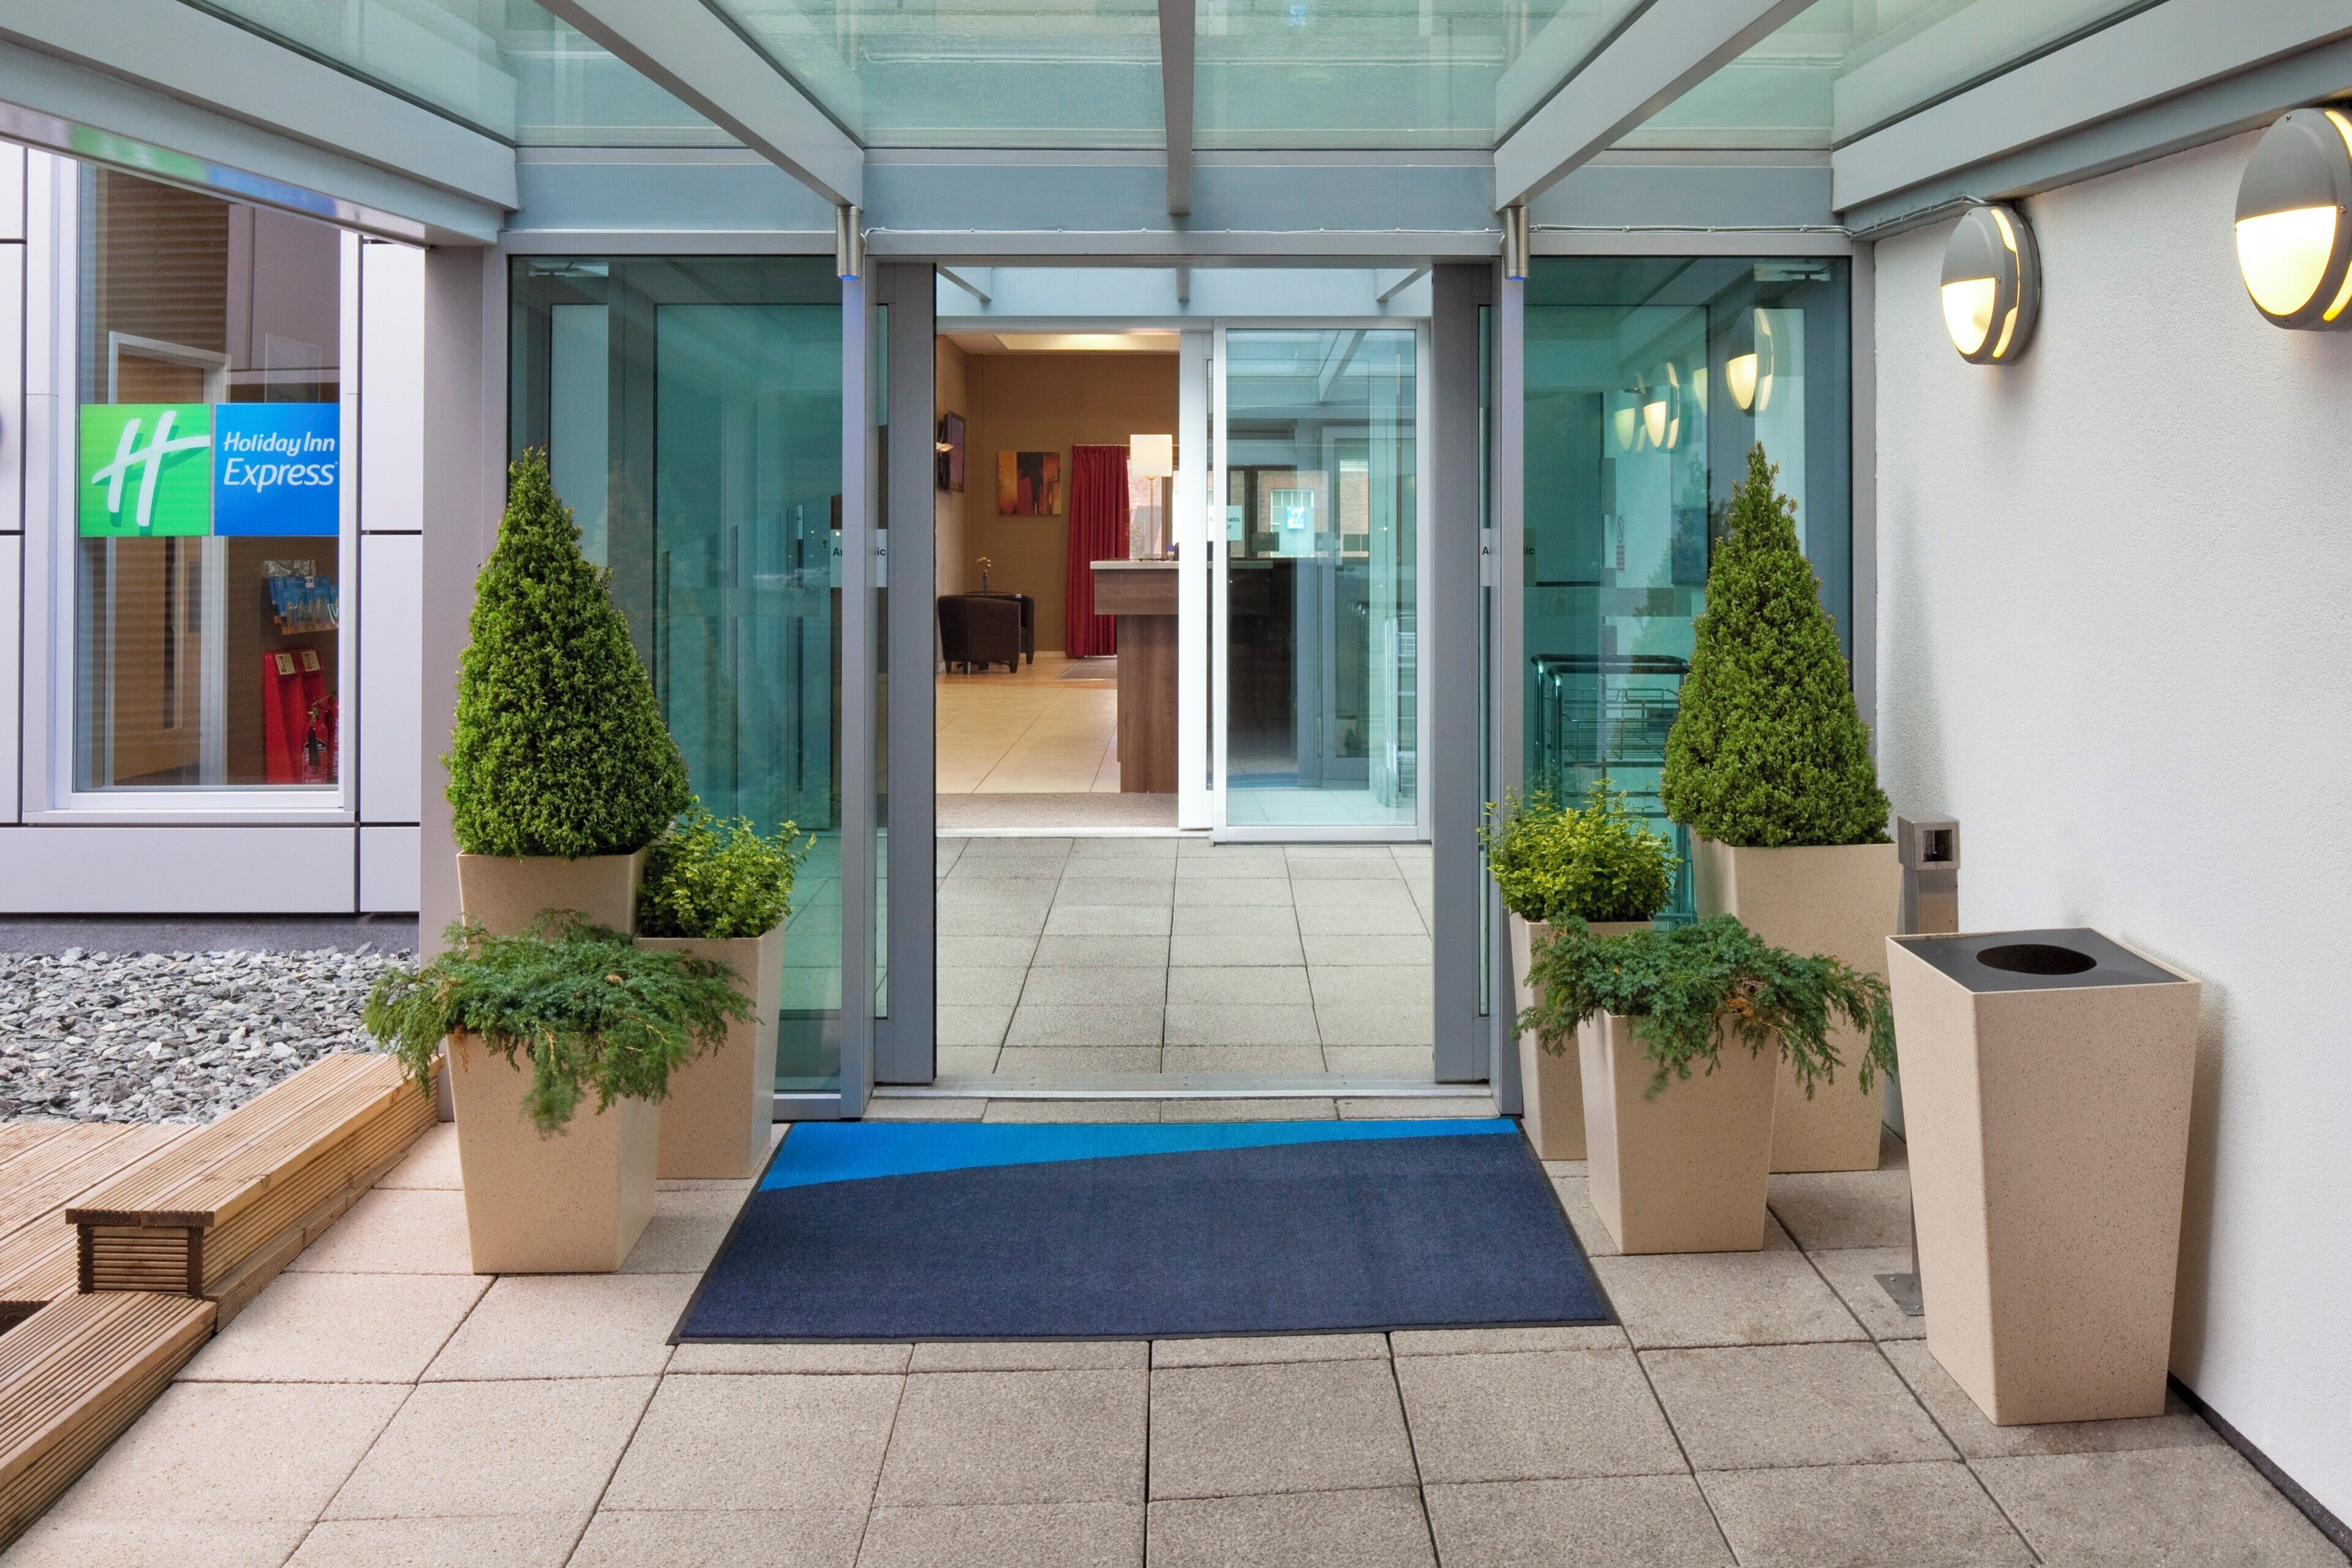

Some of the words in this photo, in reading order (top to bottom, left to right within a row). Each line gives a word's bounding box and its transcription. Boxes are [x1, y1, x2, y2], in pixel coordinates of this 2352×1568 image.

[223, 431, 301, 456] Holiday
[303, 431, 336, 451] Inn
[92, 410, 211, 527] H
[223, 458, 336, 493] Express
